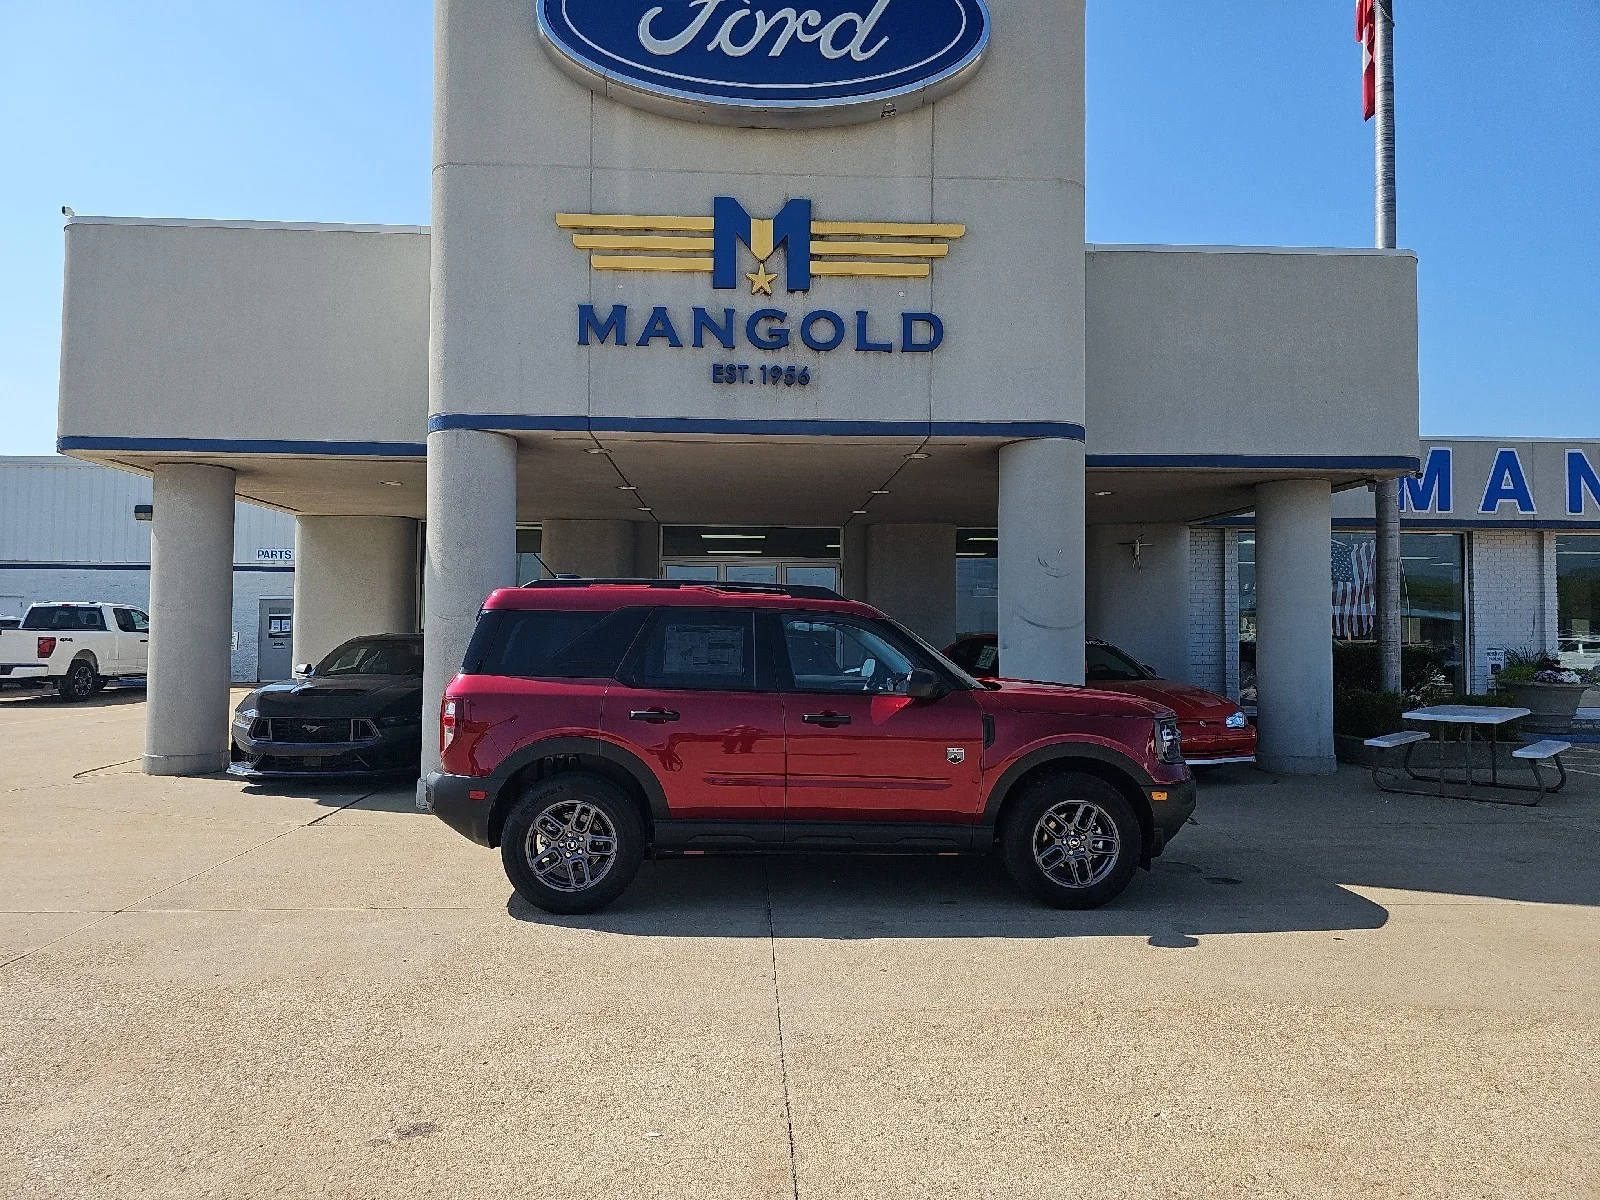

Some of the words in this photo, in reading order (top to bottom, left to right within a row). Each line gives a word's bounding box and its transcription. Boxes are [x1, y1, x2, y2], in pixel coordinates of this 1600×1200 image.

[638, 0, 889, 61] Ford
[577, 304, 944, 353] MANGOLD
[712, 363, 754, 385] EST.
[759, 365, 811, 386] 1956
[257, 549, 292, 560] PARTS
